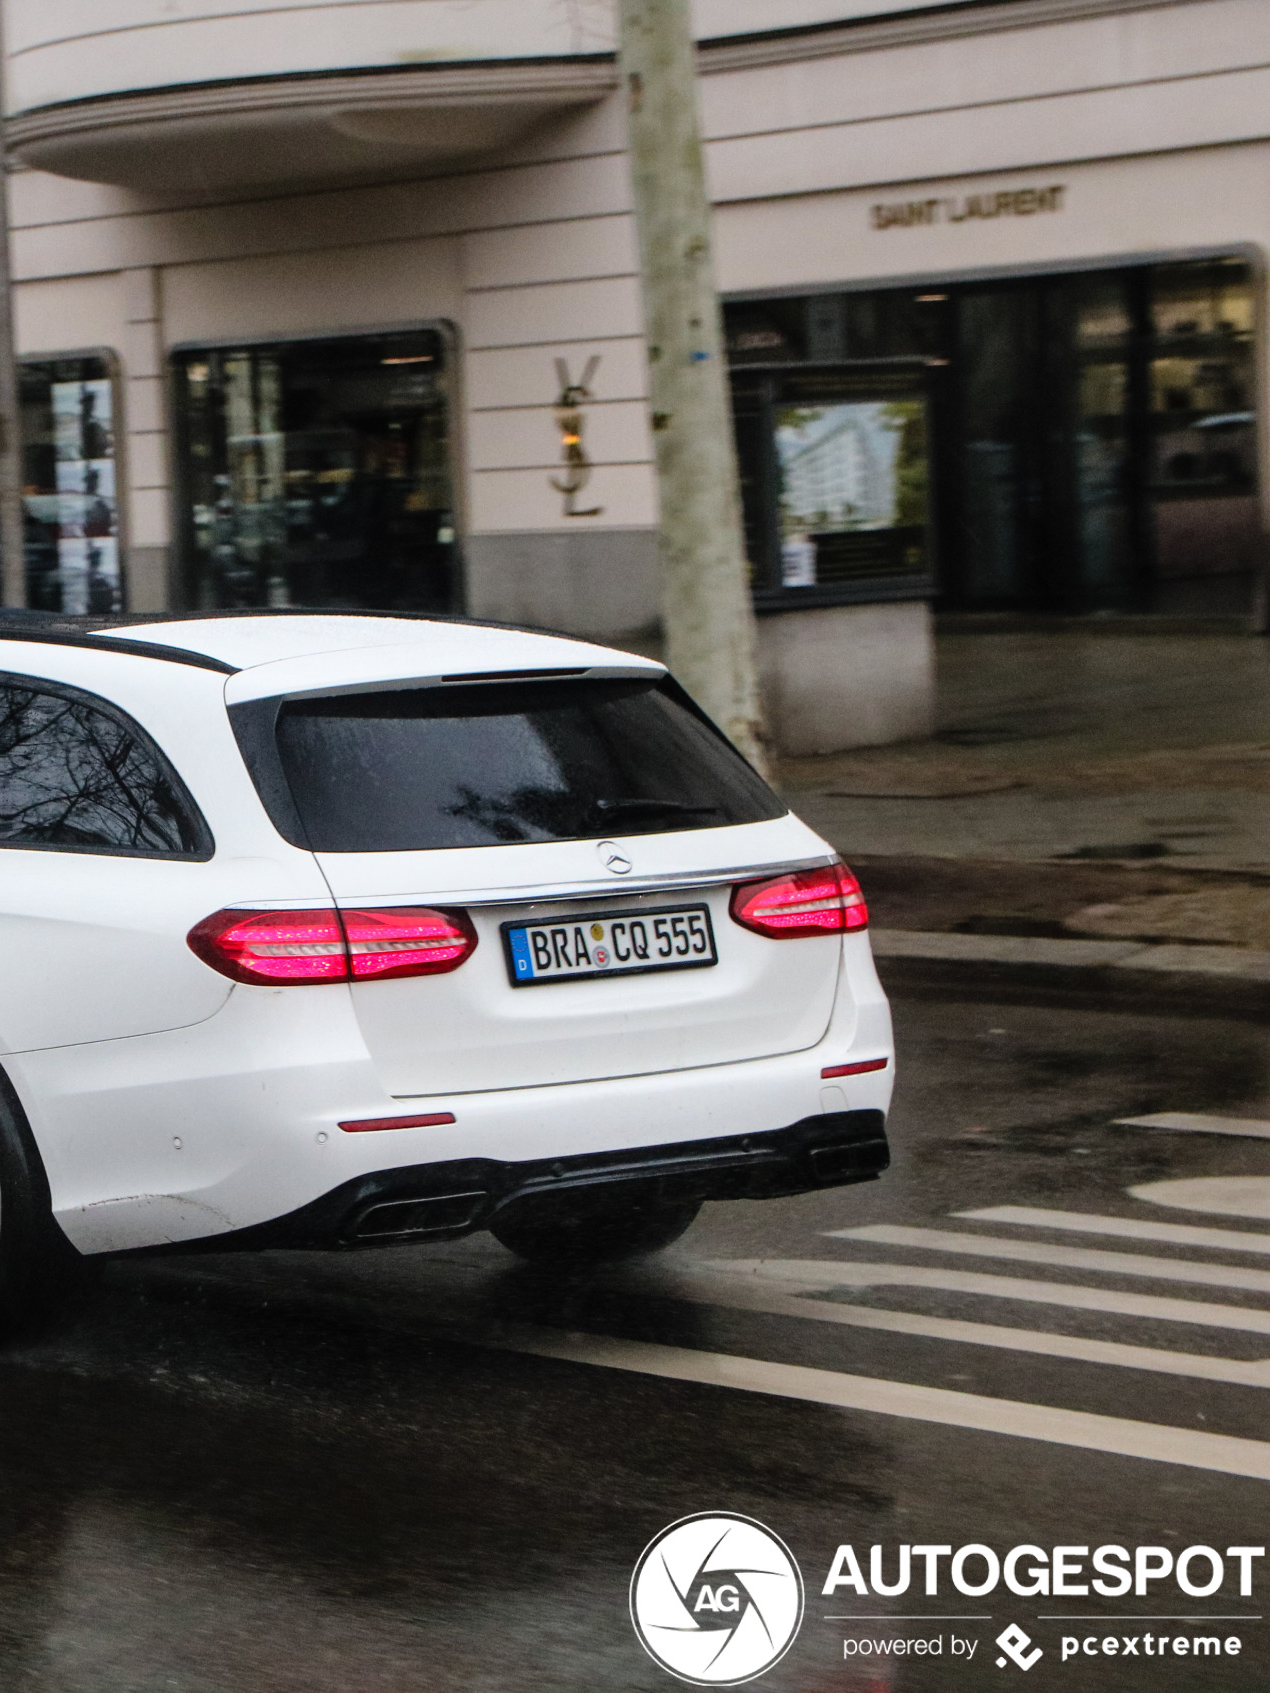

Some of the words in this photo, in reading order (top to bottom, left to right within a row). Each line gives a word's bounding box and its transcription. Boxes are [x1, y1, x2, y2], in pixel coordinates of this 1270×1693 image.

[871, 198, 938, 230] SAINT
[947, 184, 1065, 223] LAURENT
[518, 959, 528, 971] D
[531, 927, 592, 970] BRA
[611, 921, 650, 962] CQ
[653, 915, 707, 957] 555
